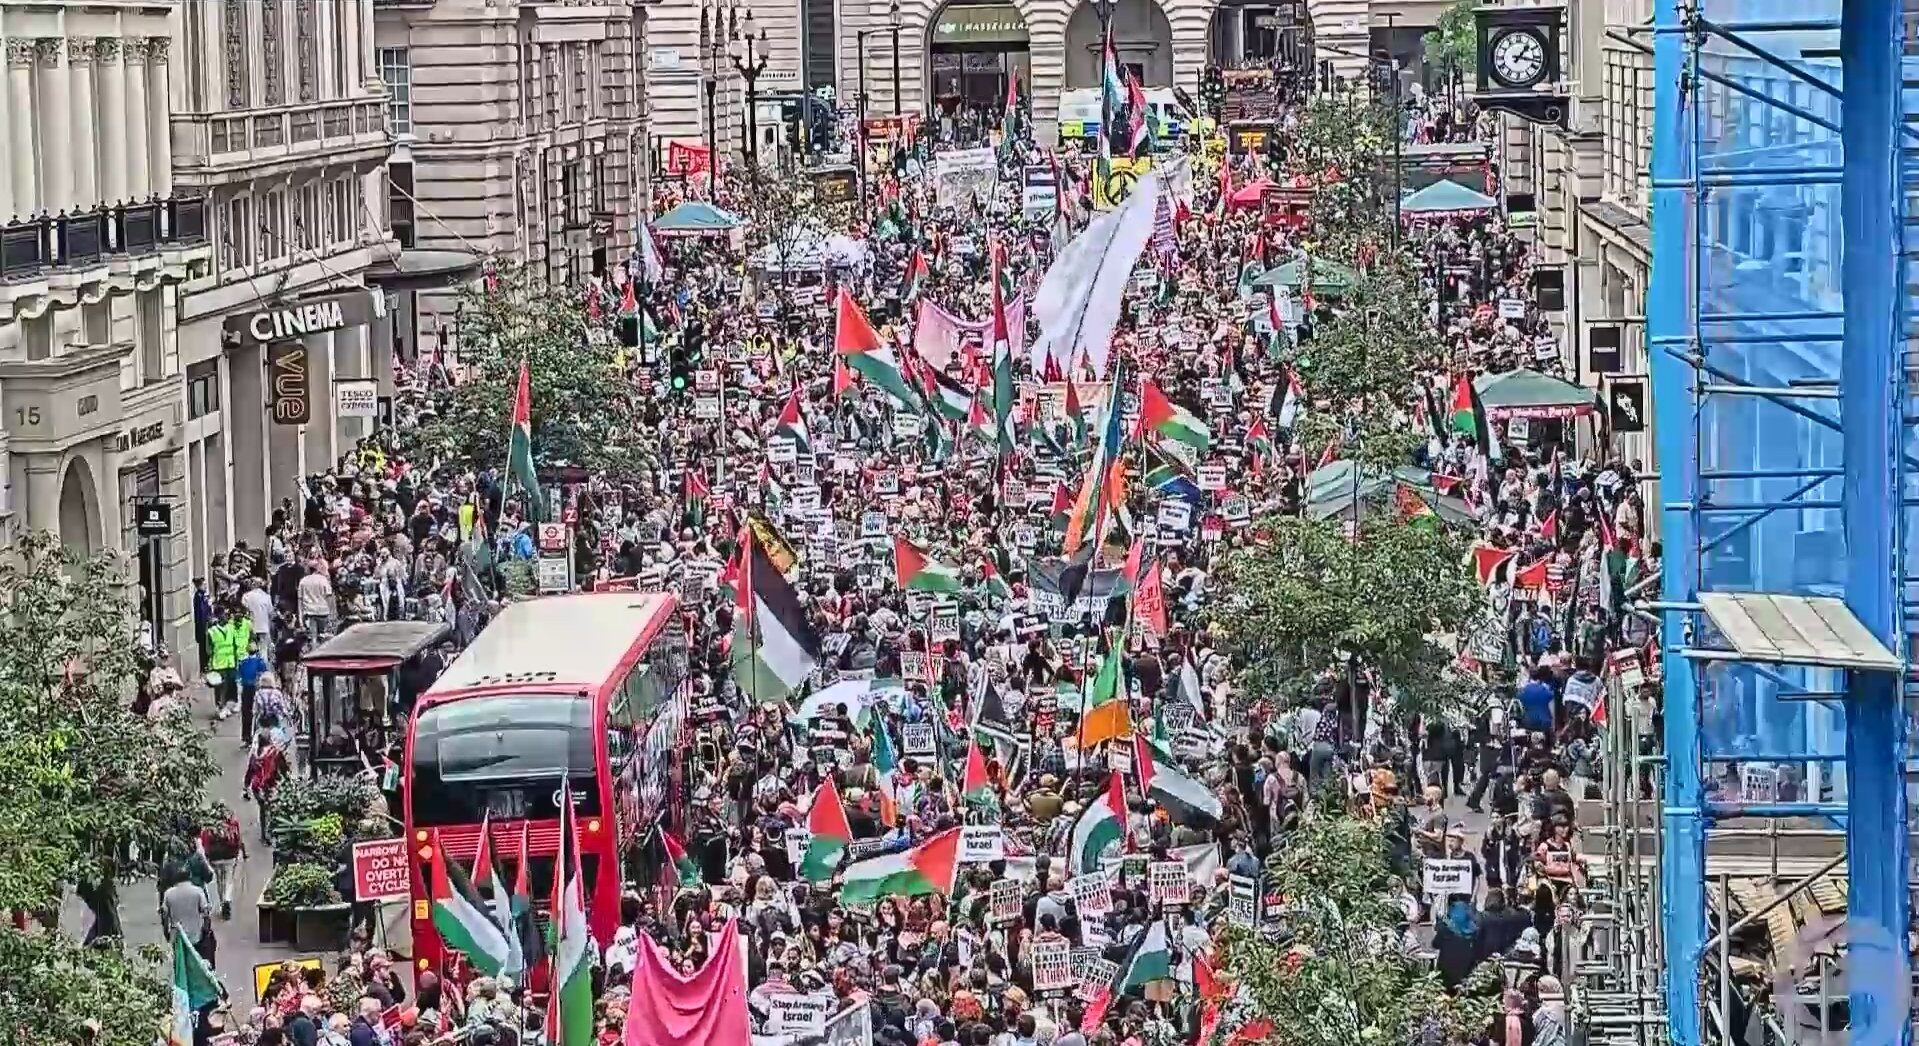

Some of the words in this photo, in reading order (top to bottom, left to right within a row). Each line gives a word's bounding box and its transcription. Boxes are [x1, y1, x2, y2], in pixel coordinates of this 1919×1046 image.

[251, 301, 344, 340] CINEMA
[341, 390, 373, 398] TESCO
[16, 406, 41, 425] 15
[933, 618, 958, 631] FREE
[966, 839, 992, 848] Israel
[356, 847, 397, 858] NARROW
[371, 858, 389, 869] DO
[393, 855, 409, 867] NO
[1442, 864, 1470, 872] Arming
[366, 867, 410, 882] OVERTA
[1432, 873, 1460, 883] Israel
[369, 879, 411, 893] CYCLIS
[772, 1000, 792, 1011] Stop
[793, 1000, 825, 1012] Arming
[783, 1011, 813, 1022] Israel
